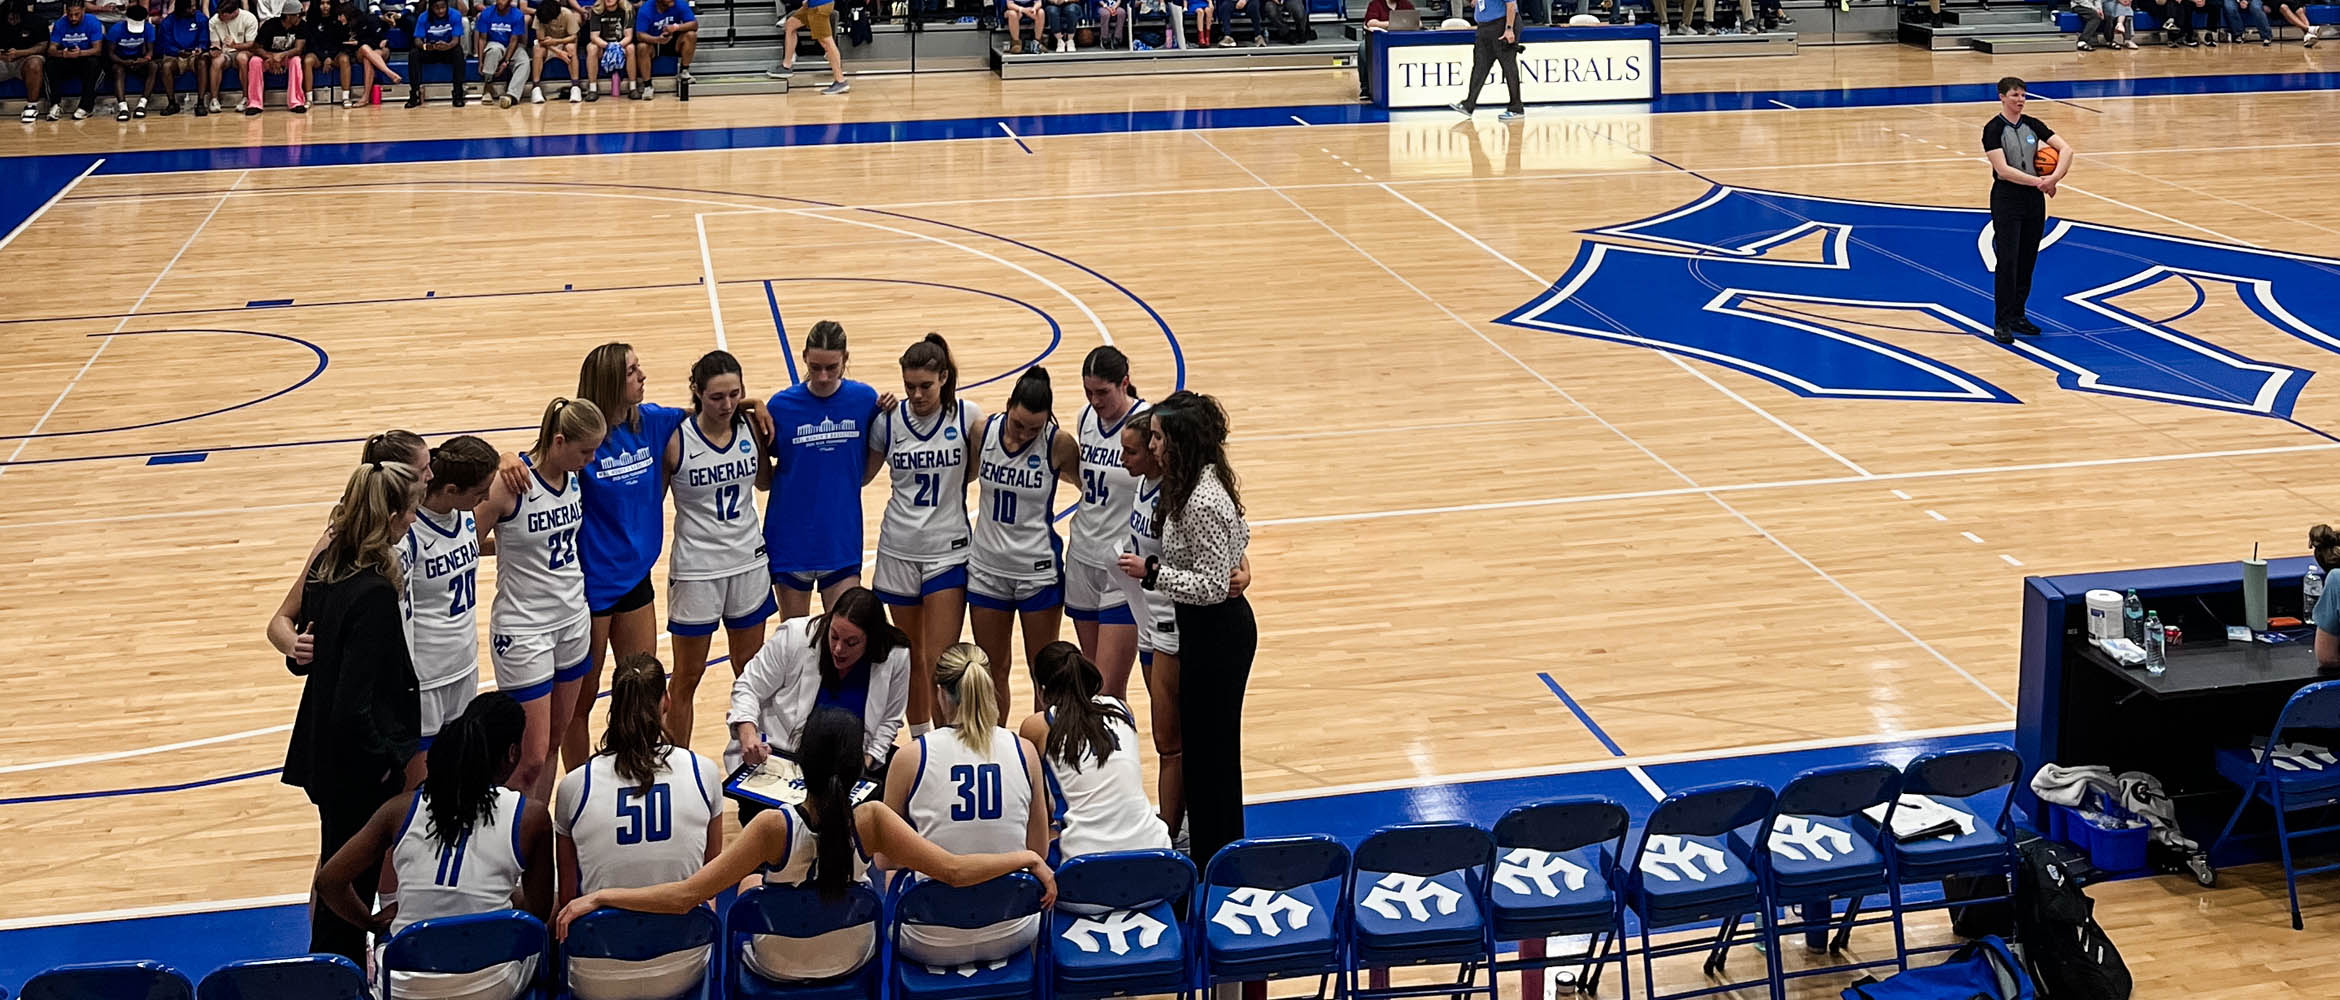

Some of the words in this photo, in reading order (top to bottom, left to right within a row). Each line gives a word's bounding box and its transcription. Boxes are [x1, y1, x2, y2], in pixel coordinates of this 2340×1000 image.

[1398, 61, 1464, 88] THE
[1483, 55, 1641, 86] NERALS
[689, 456, 756, 487] GENERALS
[892, 448, 961, 470] GENERALS
[715, 484, 740, 521] 12
[914, 473, 940, 507] 21
[1083, 469, 1109, 506] 34
[992, 488, 1017, 525] 10
[548, 528, 575, 570] 22
[449, 567, 476, 617] 20
[950, 763, 1001, 821] 30
[616, 783, 672, 845] 50
